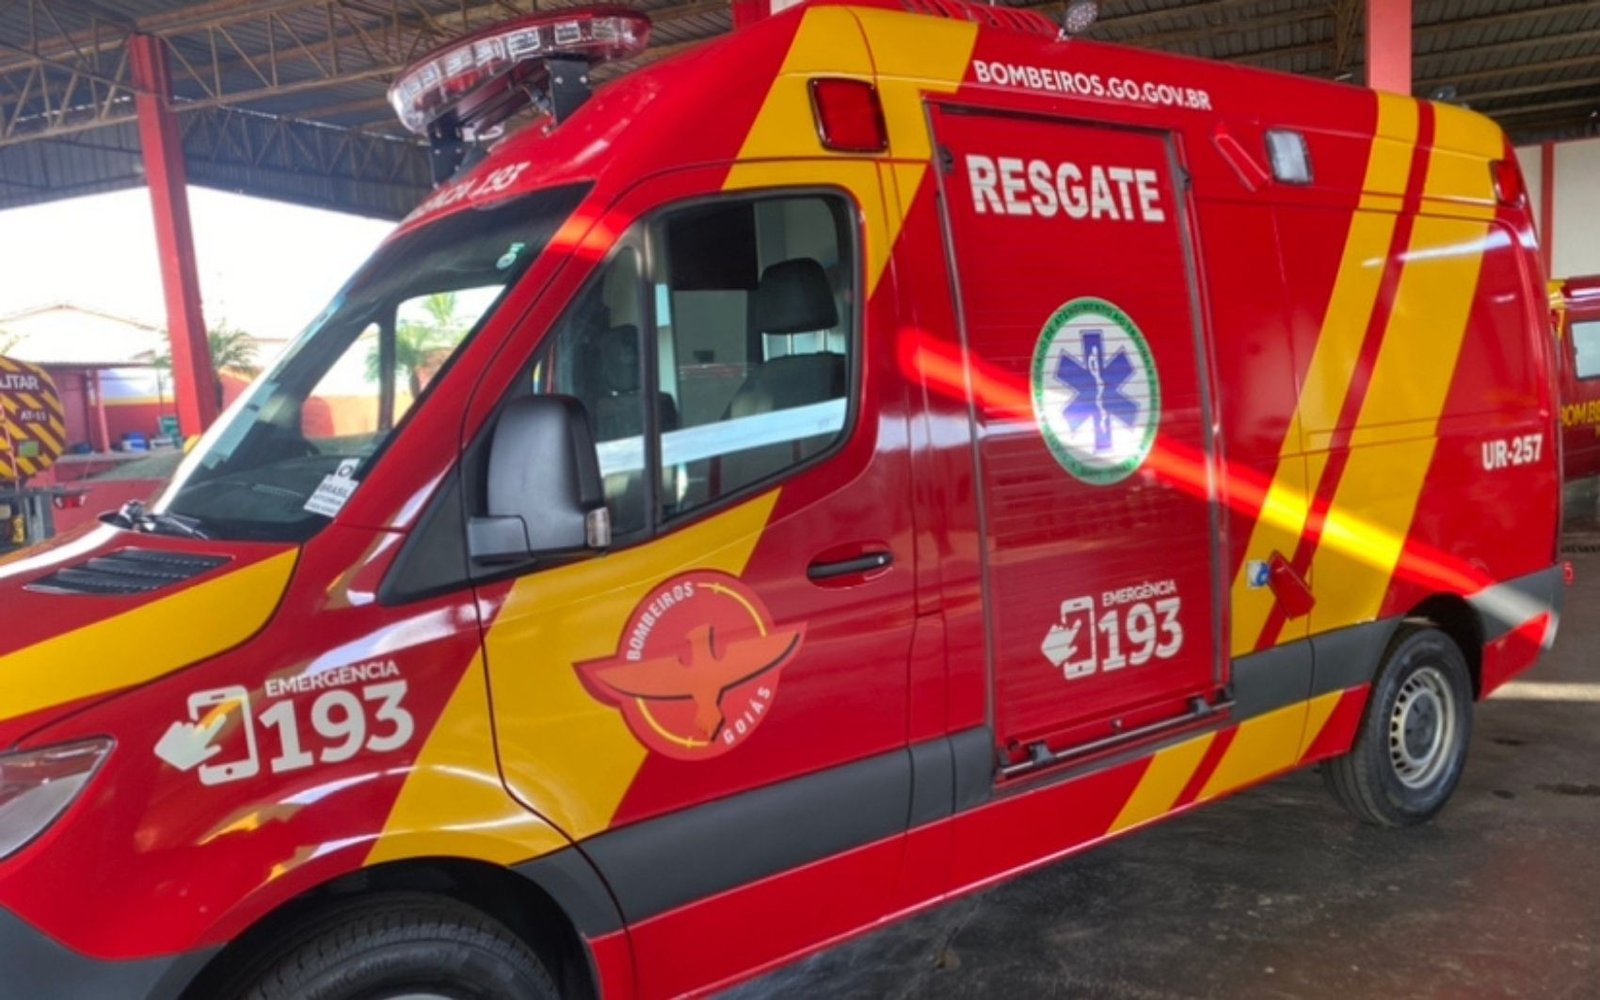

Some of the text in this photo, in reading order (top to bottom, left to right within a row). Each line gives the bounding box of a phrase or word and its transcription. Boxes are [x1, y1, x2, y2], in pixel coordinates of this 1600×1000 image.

[973, 60, 1212, 110] BOMBEIROS.GO.GOV.BR
[965, 154, 1165, 222] RESGATE
[1482, 434, 1543, 471] UR-257
[626, 581, 695, 662] BOMBEIROS
[1102, 579, 1177, 608] EMERGÊNCIA
[1098, 597, 1184, 673] 193
[258, 680, 415, 774] 193
